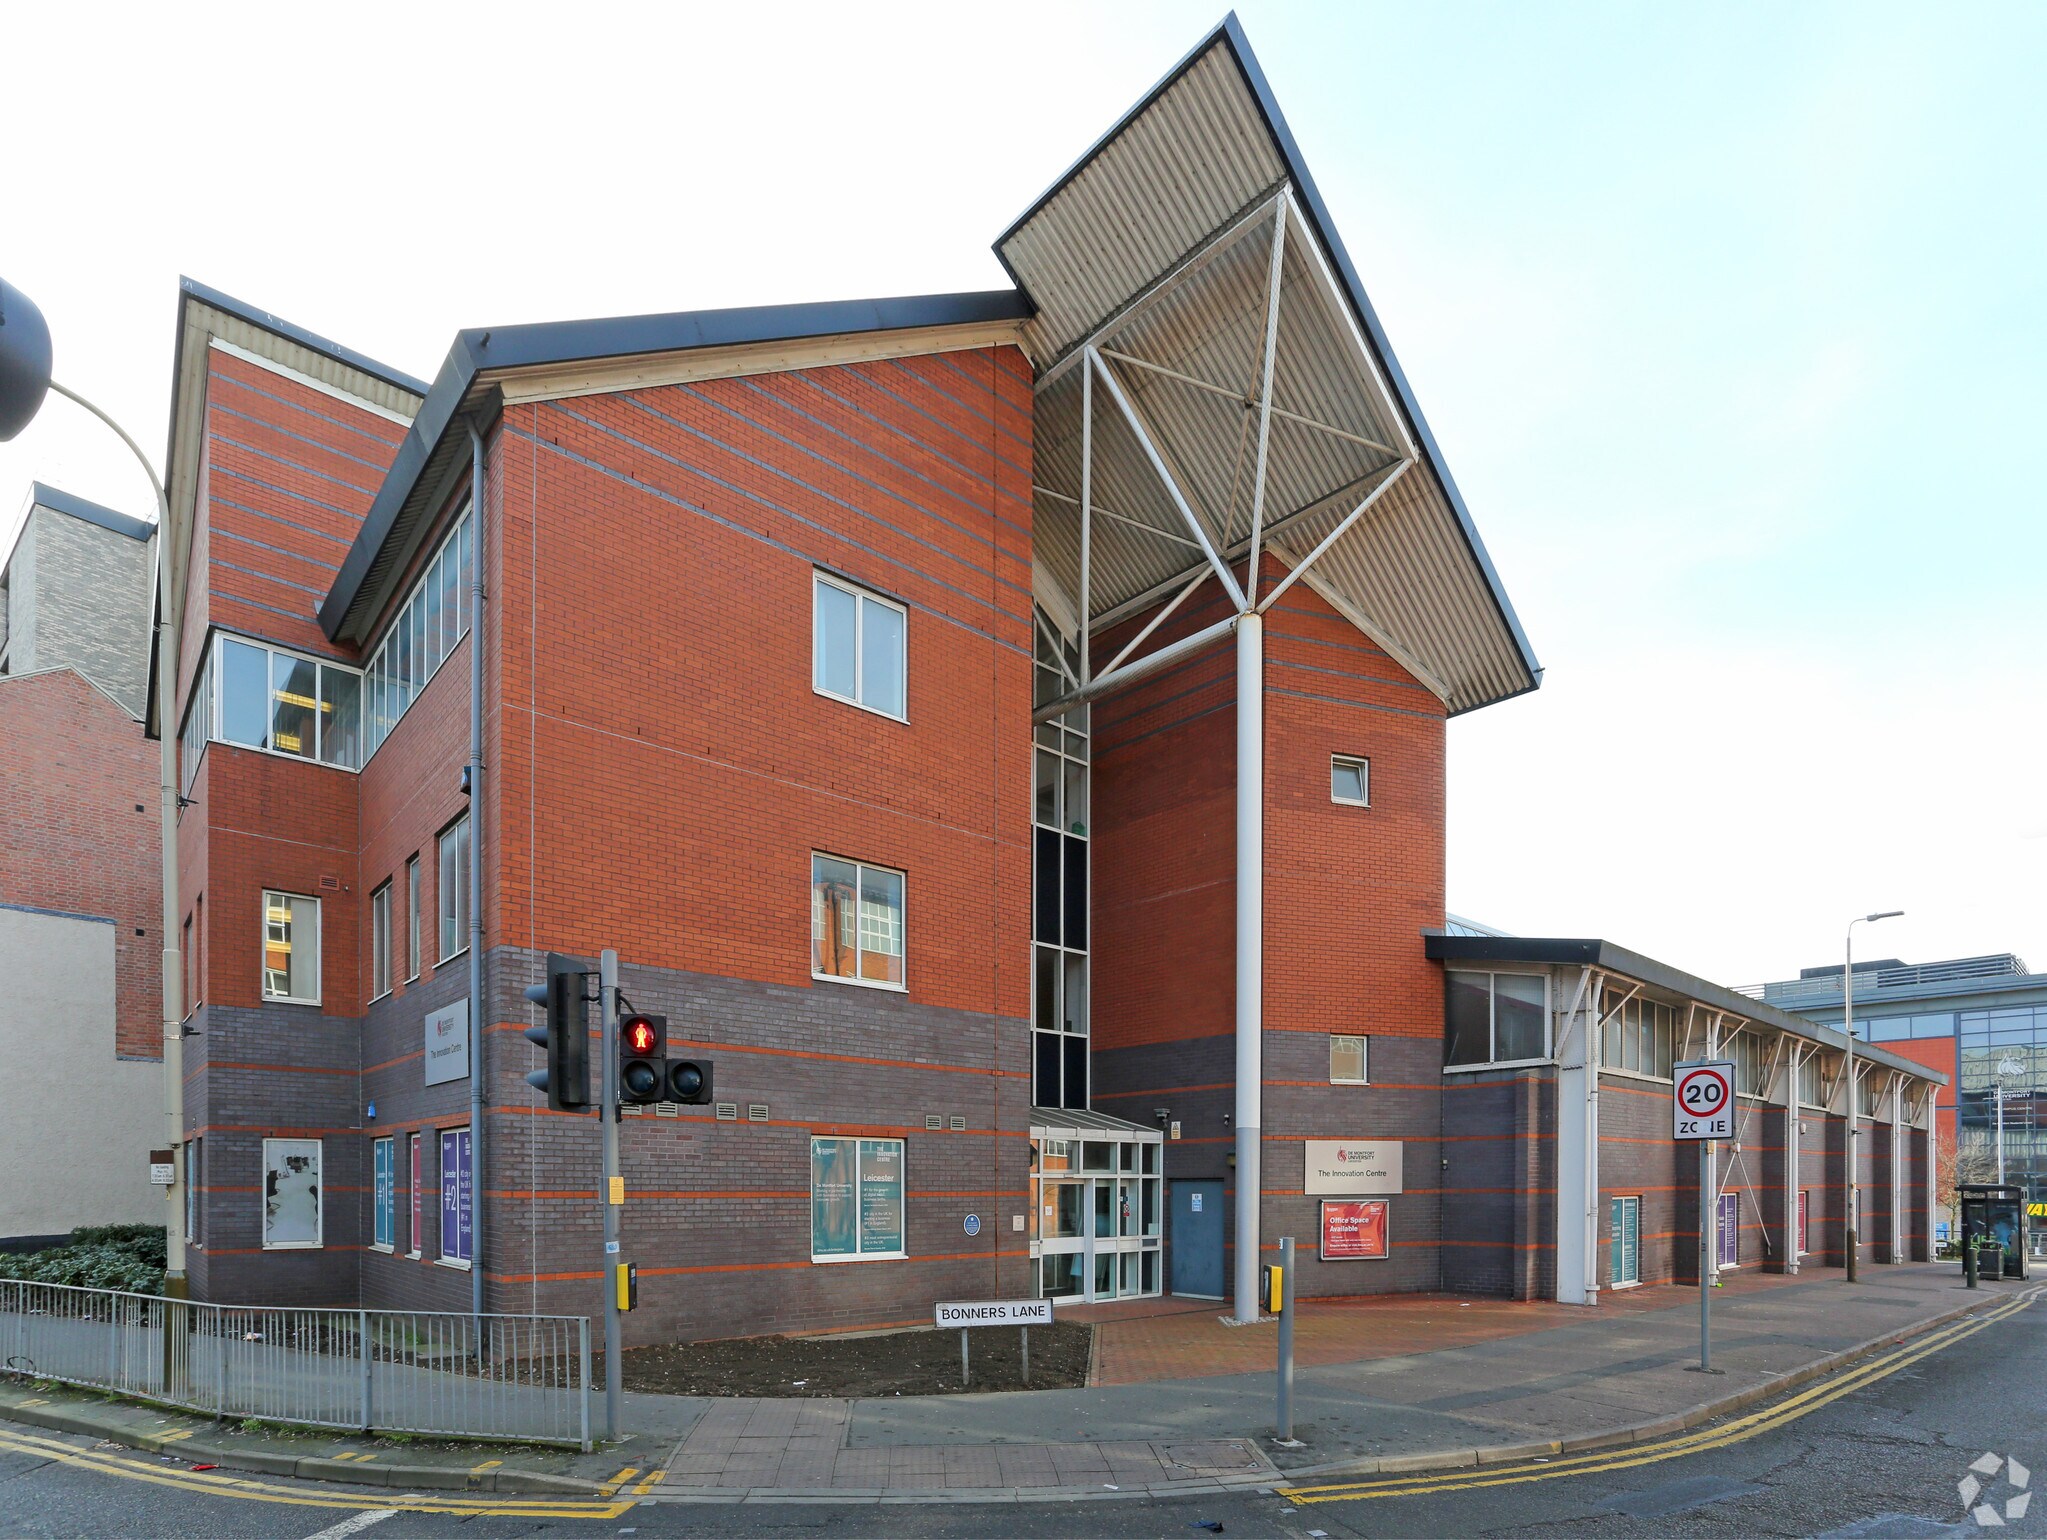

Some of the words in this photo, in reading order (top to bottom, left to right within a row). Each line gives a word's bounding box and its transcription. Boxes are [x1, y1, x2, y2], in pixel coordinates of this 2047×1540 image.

[437, 1047, 450, 1058] Innovation
[451, 1043, 462, 1053] Centre
[1686, 1083, 1721, 1104] 20
[1680, 1120, 1726, 1133] ZOE
[1318, 1169, 1331, 1177] The
[1332, 1169, 1364, 1177] Innovation
[1365, 1169, 1387, 1177] Centre
[378, 1183, 385, 1206] #1
[444, 1184, 457, 1211] #2
[1350, 1217, 1369, 1225] Space
[942, 1307, 1006, 1320] BONNERS
[1012, 1305, 1046, 1317] LANE
